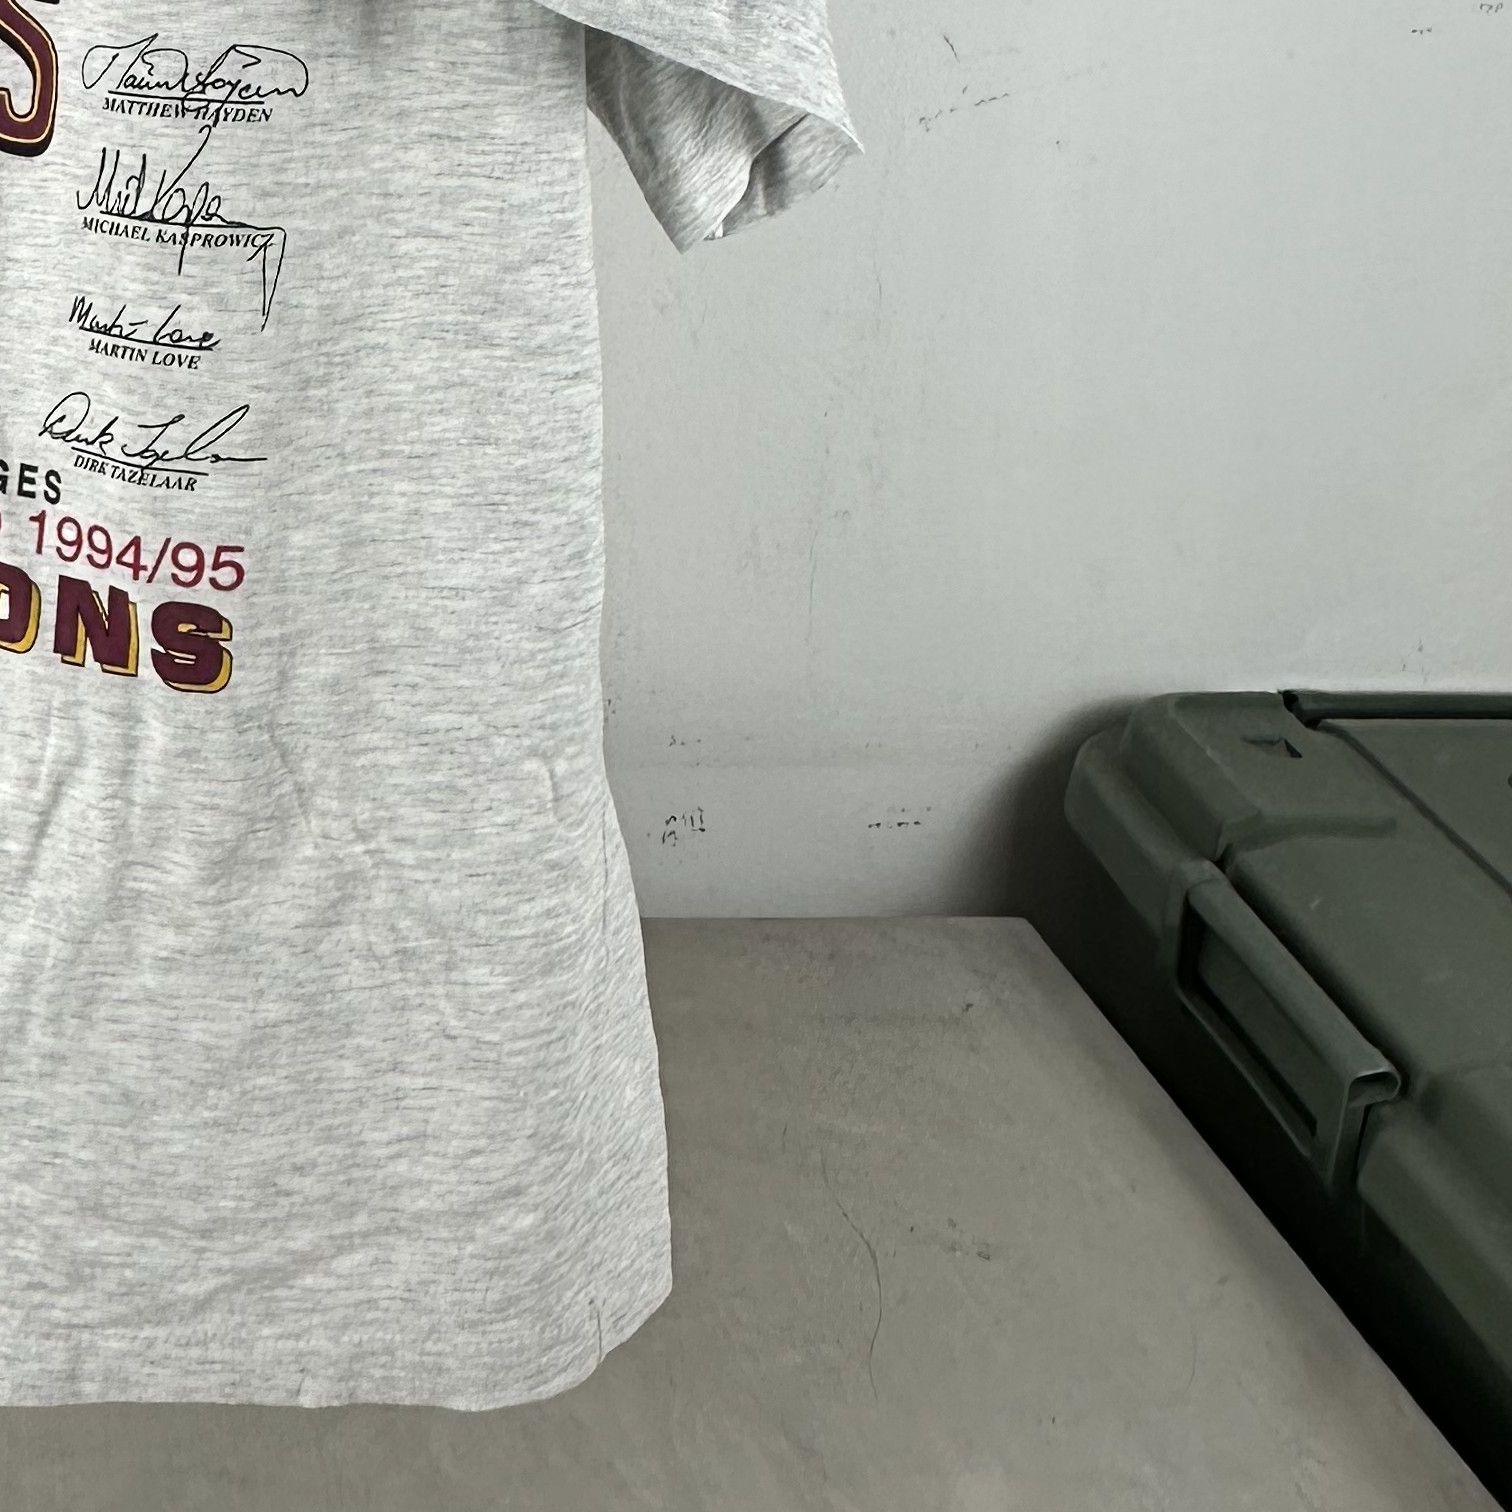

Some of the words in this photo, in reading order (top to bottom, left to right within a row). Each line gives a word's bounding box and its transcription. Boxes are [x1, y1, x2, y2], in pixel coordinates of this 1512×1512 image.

[102, 97, 188, 120] MATTHEW
[194, 107, 273, 124] HAYDEN
[82, 216, 151, 243] MICHAEL
[89, 337, 147, 363] MARTIN
[152, 352, 202, 370] LOVE
[74, 454, 109, 475] DIRK
[110, 465, 198, 491] TAZELAAR
[27, 512, 247, 592] 1994/95
